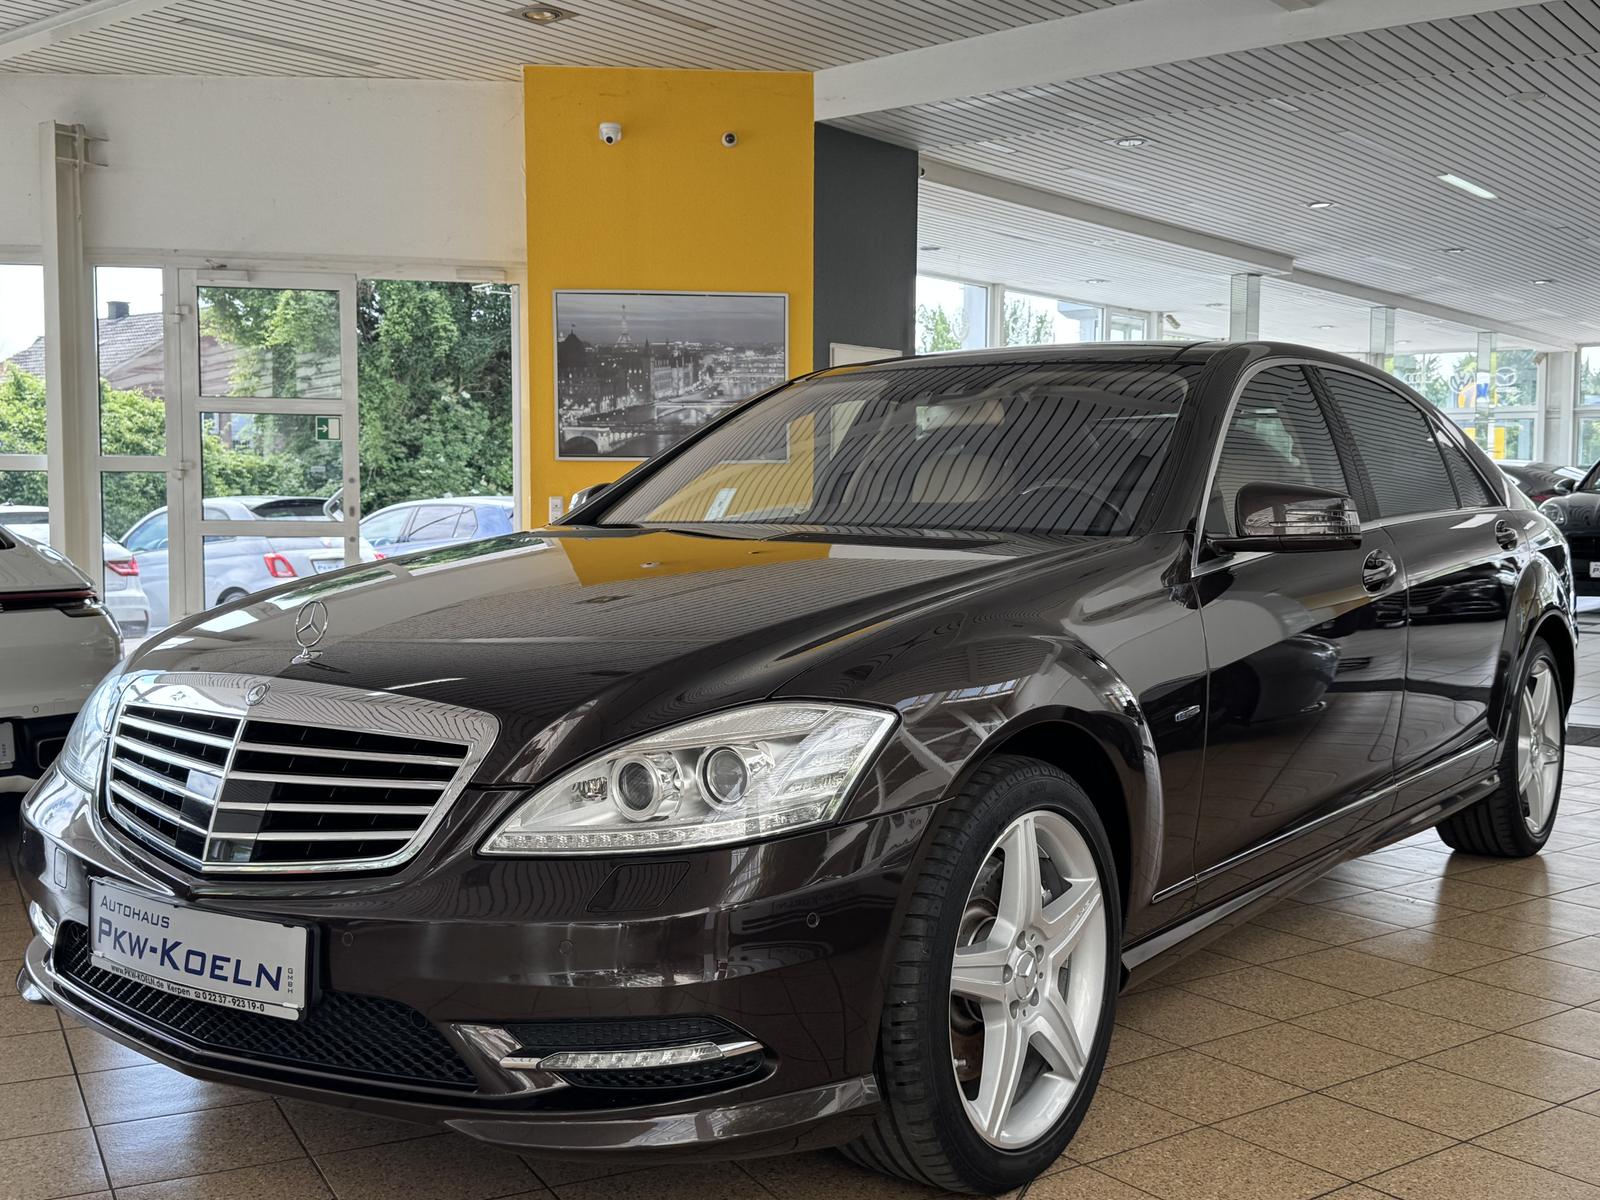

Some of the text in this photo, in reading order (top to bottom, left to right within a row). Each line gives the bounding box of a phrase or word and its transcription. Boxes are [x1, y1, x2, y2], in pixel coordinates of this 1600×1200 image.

[100, 895, 170, 929] AUTOHAUS
[98, 916, 282, 991] PKW-KOELN
[167, 983, 191, 997] Kerpen
